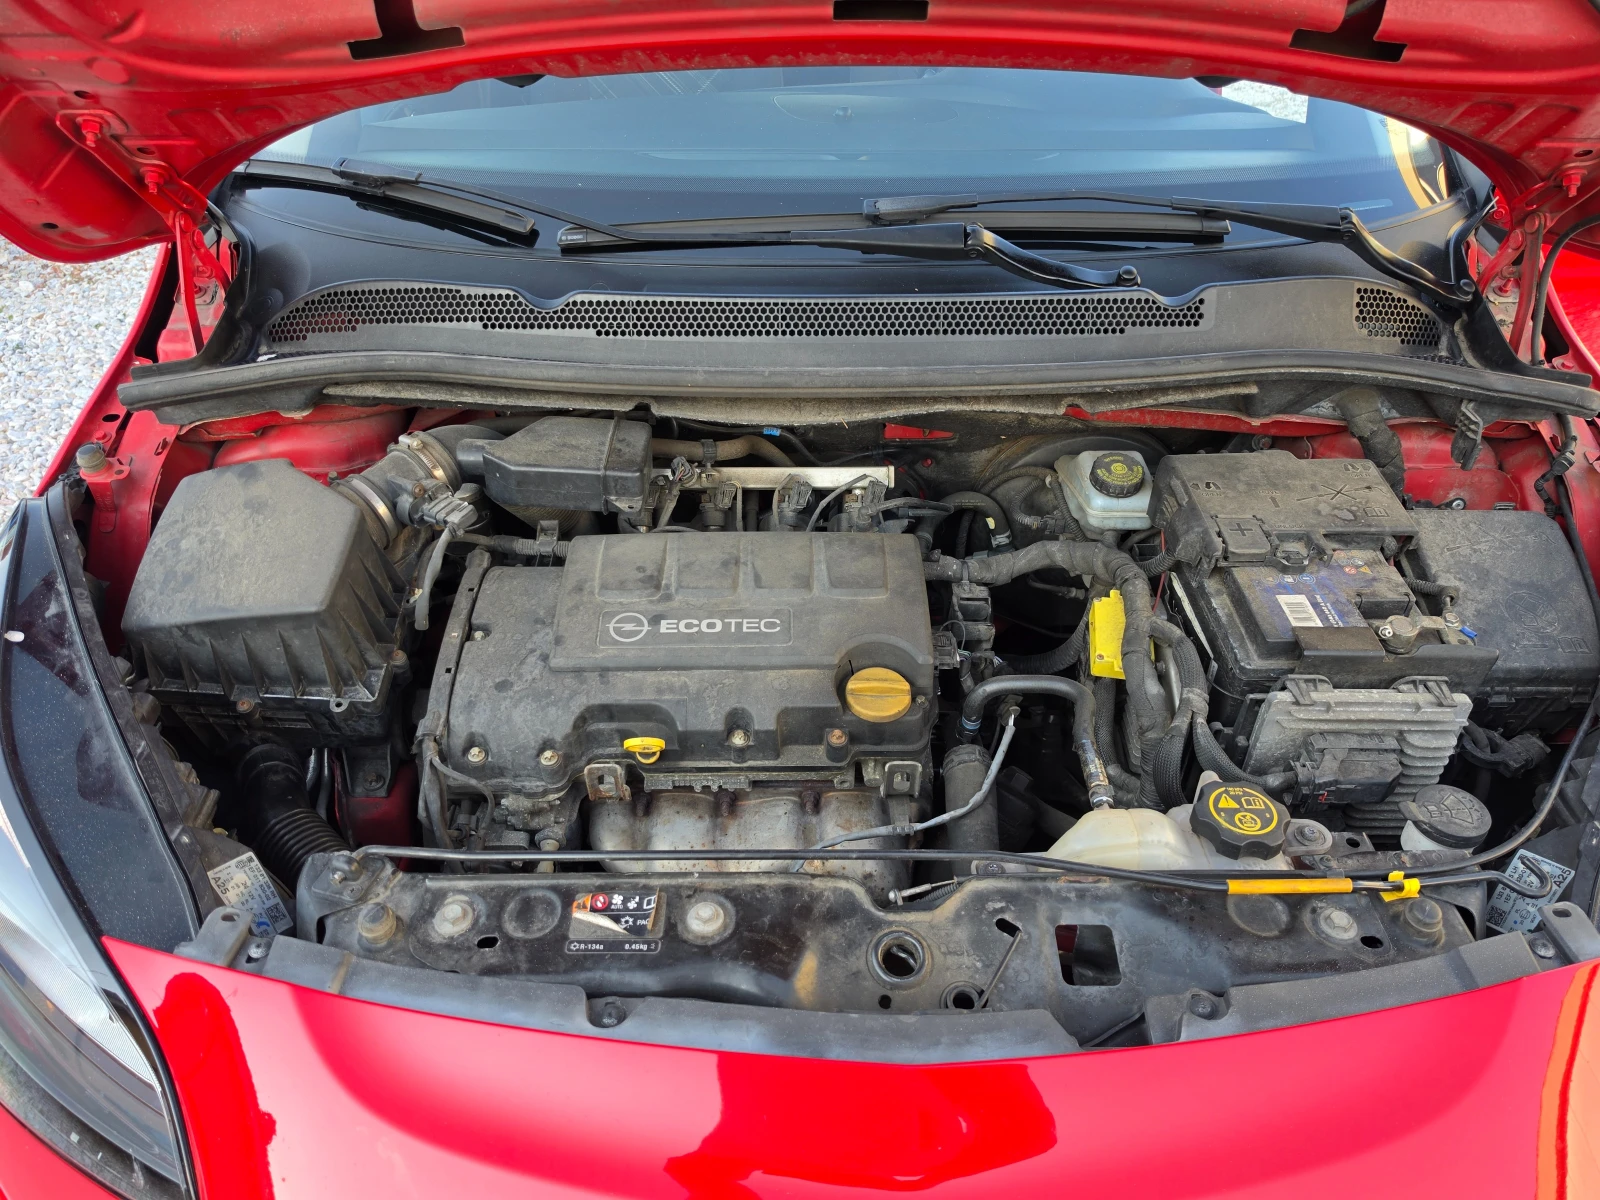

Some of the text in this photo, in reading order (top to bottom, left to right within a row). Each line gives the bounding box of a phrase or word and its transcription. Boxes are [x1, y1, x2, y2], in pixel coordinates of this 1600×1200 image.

[660, 618, 781, 633] ECOTEC
[211, 876, 230, 895] A25
[1554, 868, 1572, 888] A25
